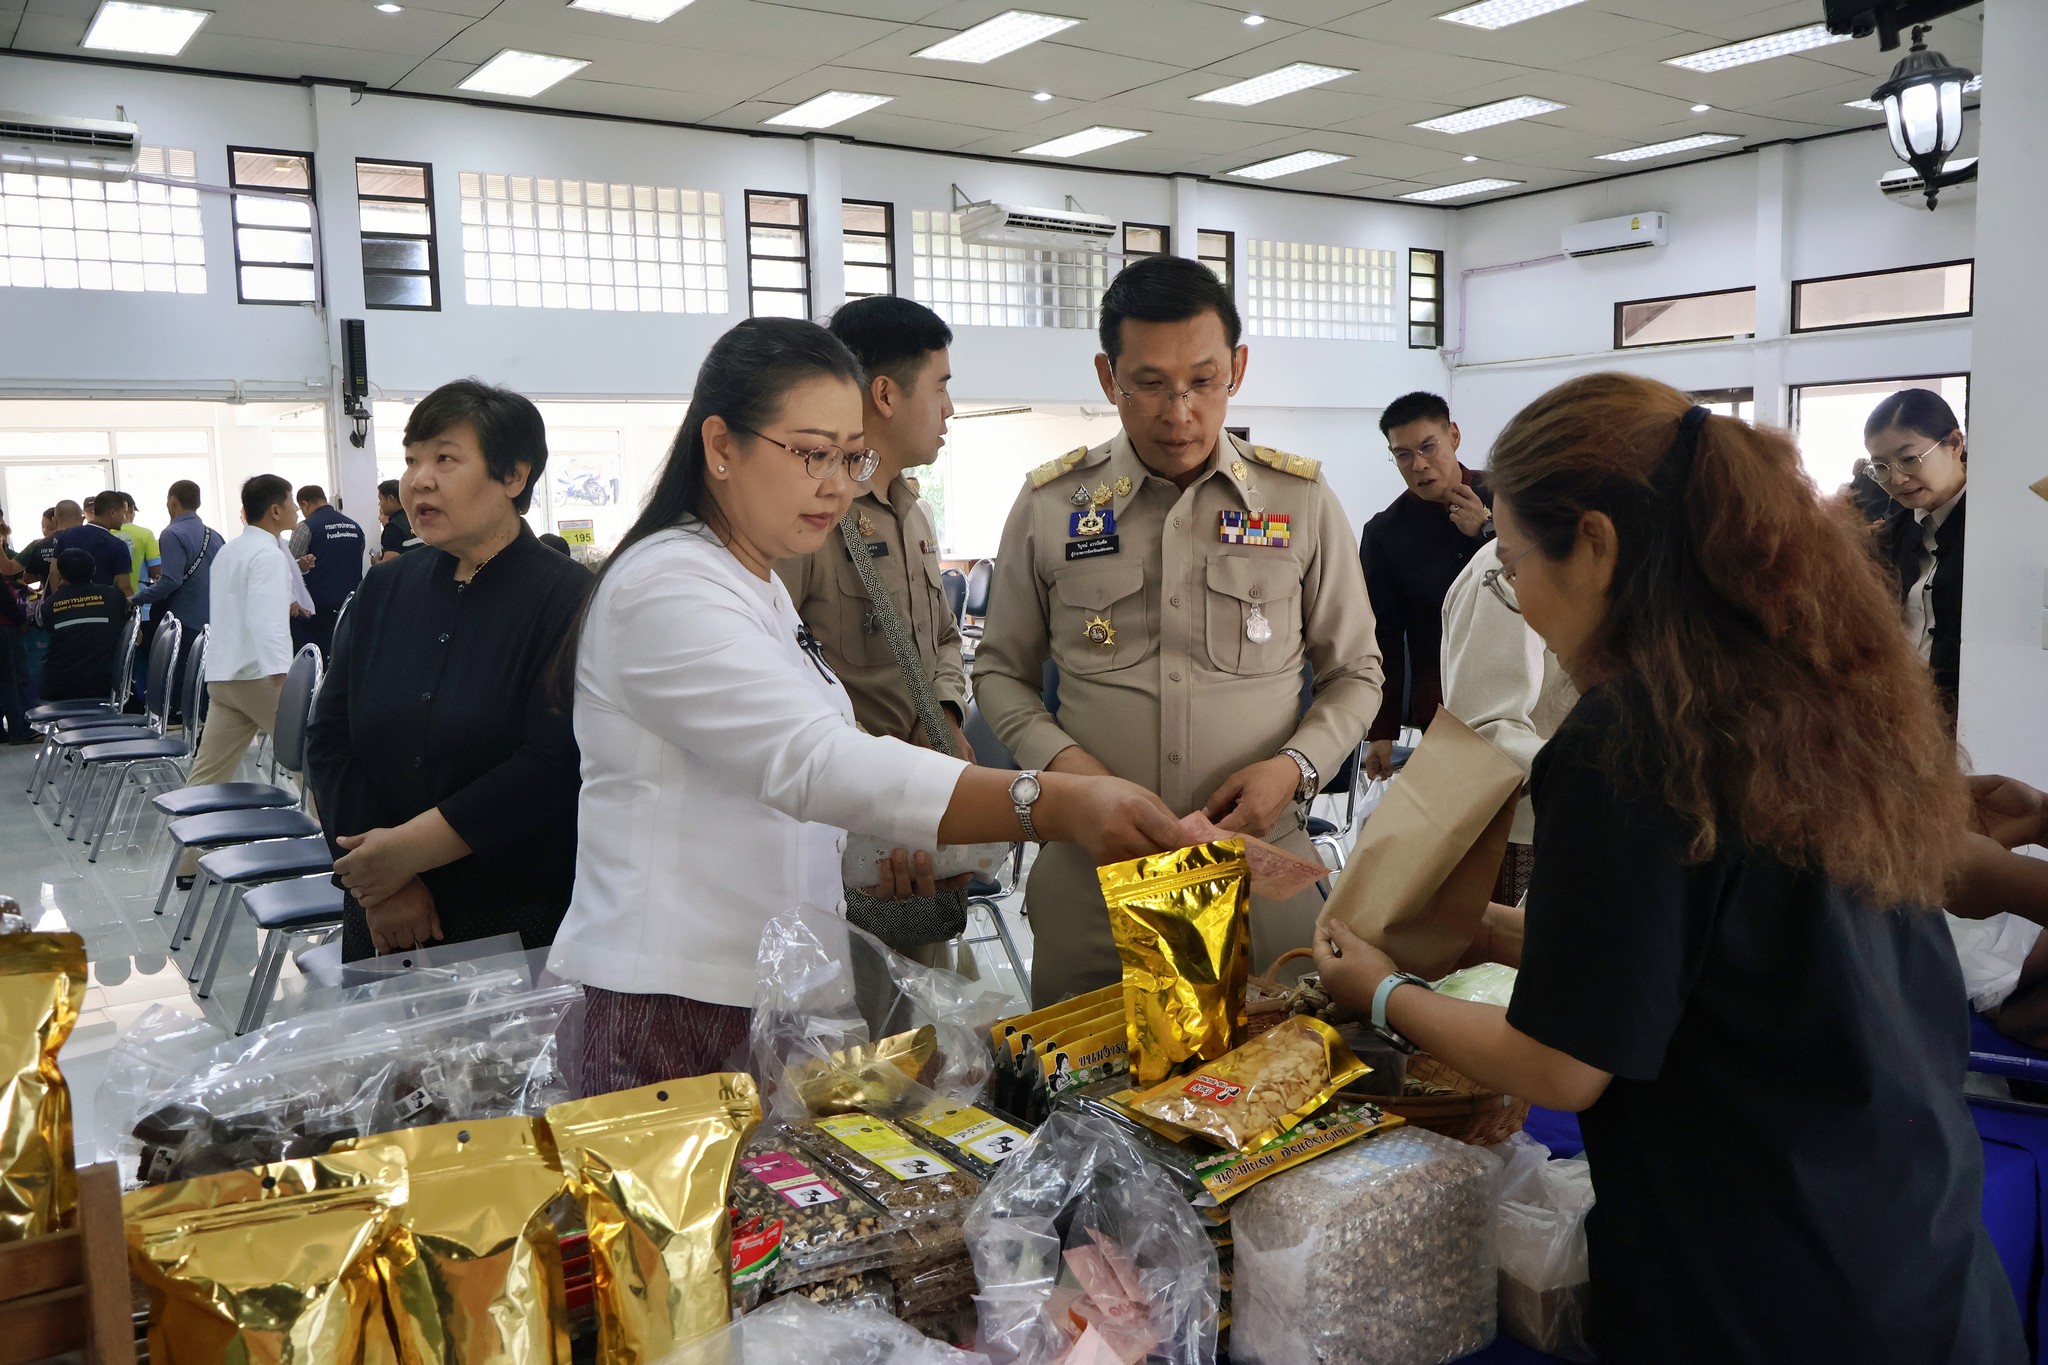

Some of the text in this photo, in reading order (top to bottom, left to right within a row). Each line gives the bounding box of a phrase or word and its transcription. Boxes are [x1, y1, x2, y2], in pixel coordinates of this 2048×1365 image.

[574, 533, 592, 543] 195
[53, 595, 103, 607] กรมการปกครอง
